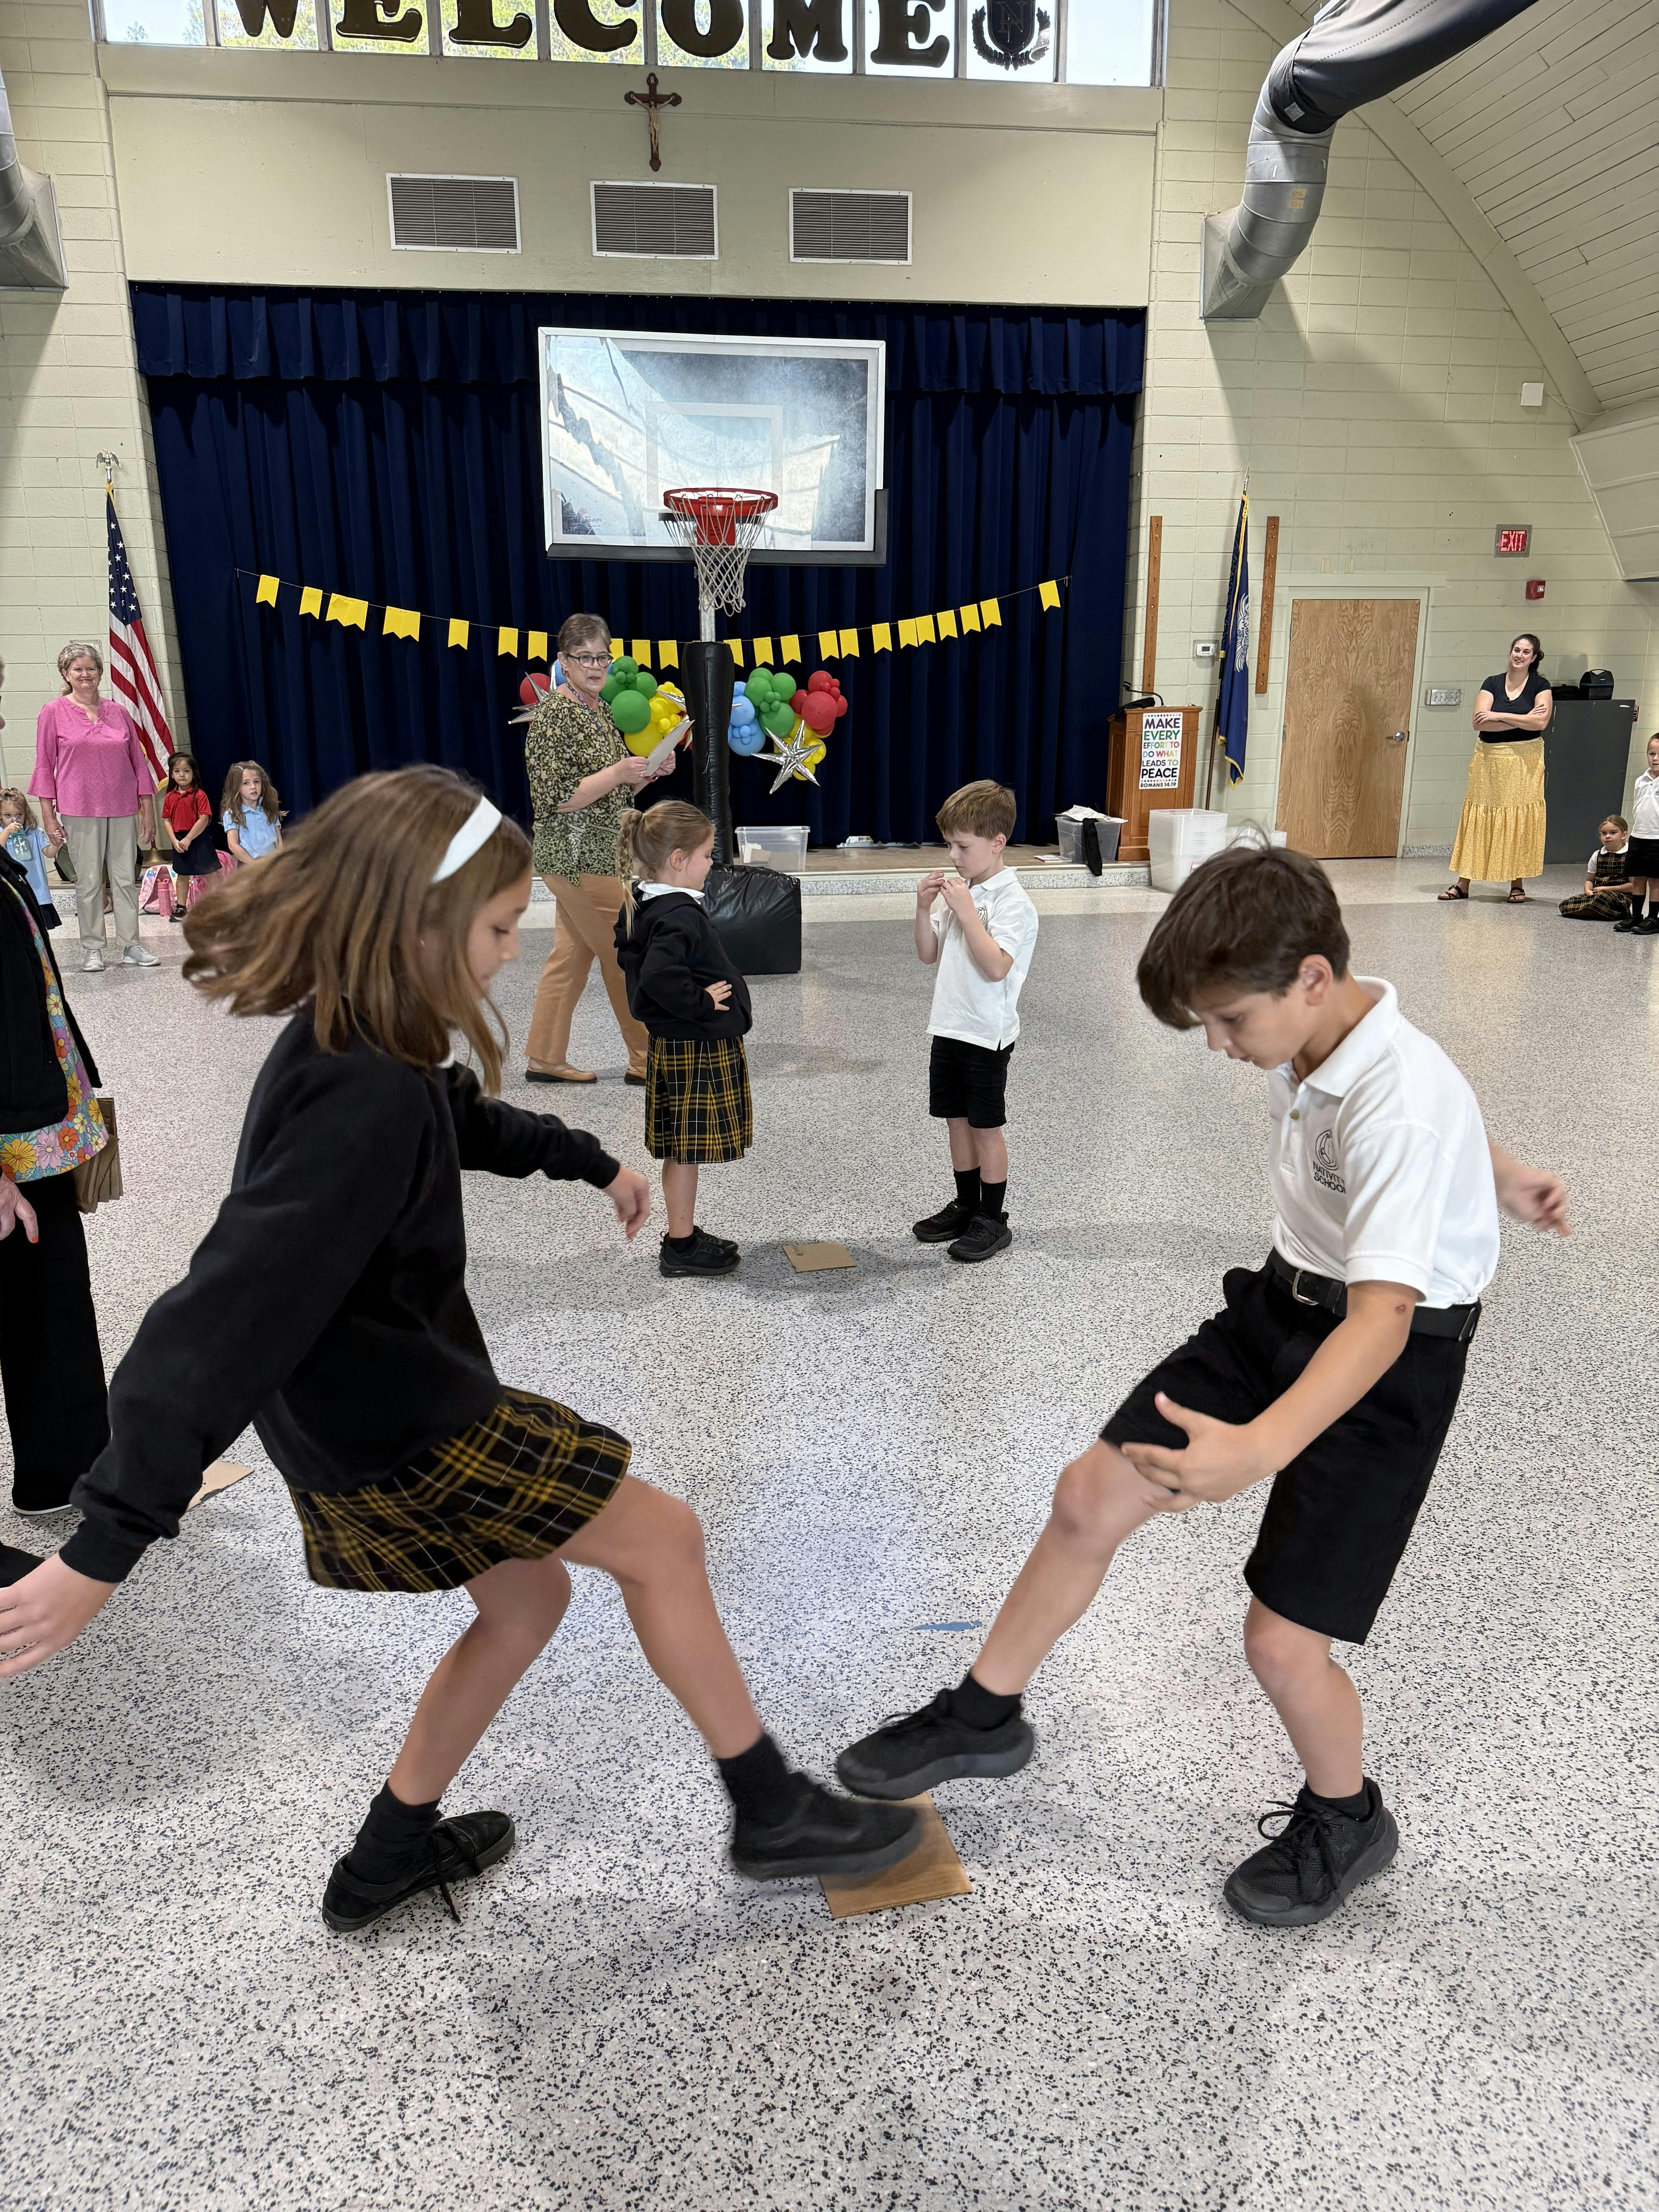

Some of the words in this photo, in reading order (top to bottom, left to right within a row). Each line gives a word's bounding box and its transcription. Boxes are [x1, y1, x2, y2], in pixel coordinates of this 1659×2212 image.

[1500, 531, 1525, 551] EXIT
[1144, 718, 1180, 729] MAKE
[1144, 730, 1180, 740] EVERY
[1141, 768, 1178, 779] PEACE
